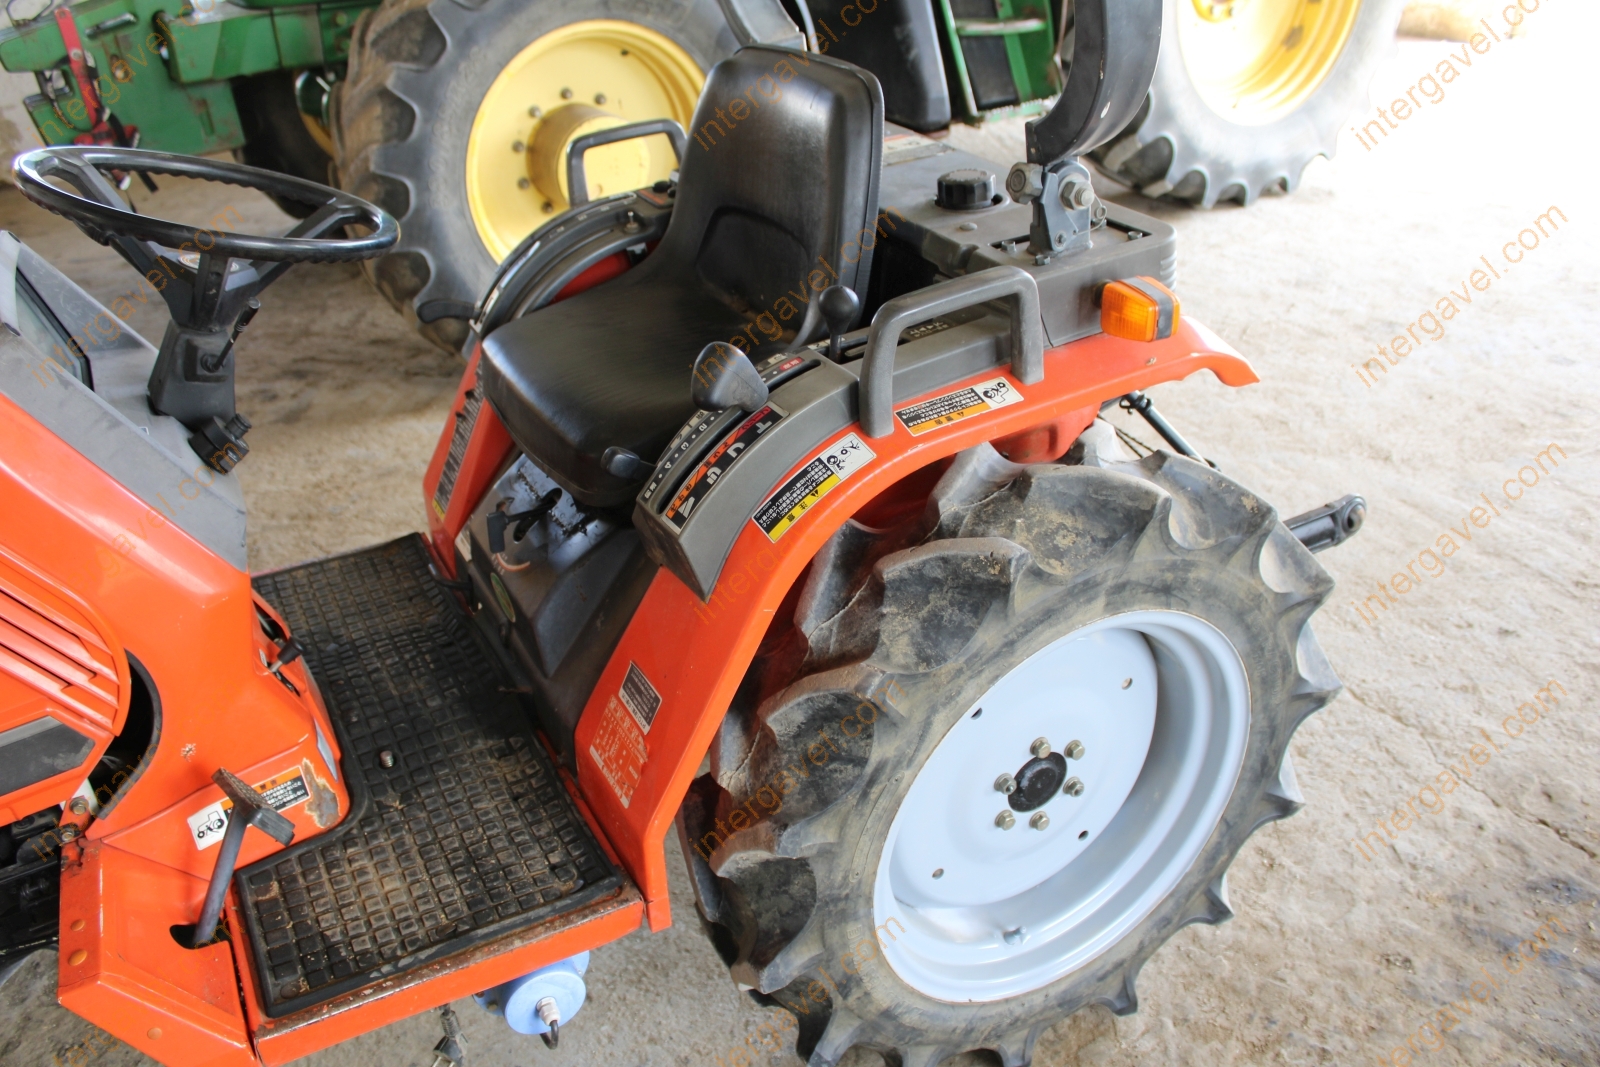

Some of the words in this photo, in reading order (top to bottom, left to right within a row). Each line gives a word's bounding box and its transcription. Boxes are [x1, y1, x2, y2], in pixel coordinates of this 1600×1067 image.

[933, 414, 954, 425] 警告
[679, 440, 690, 451] 3
[697, 421, 708, 432] 2
[784, 500, 808, 523] 注意
